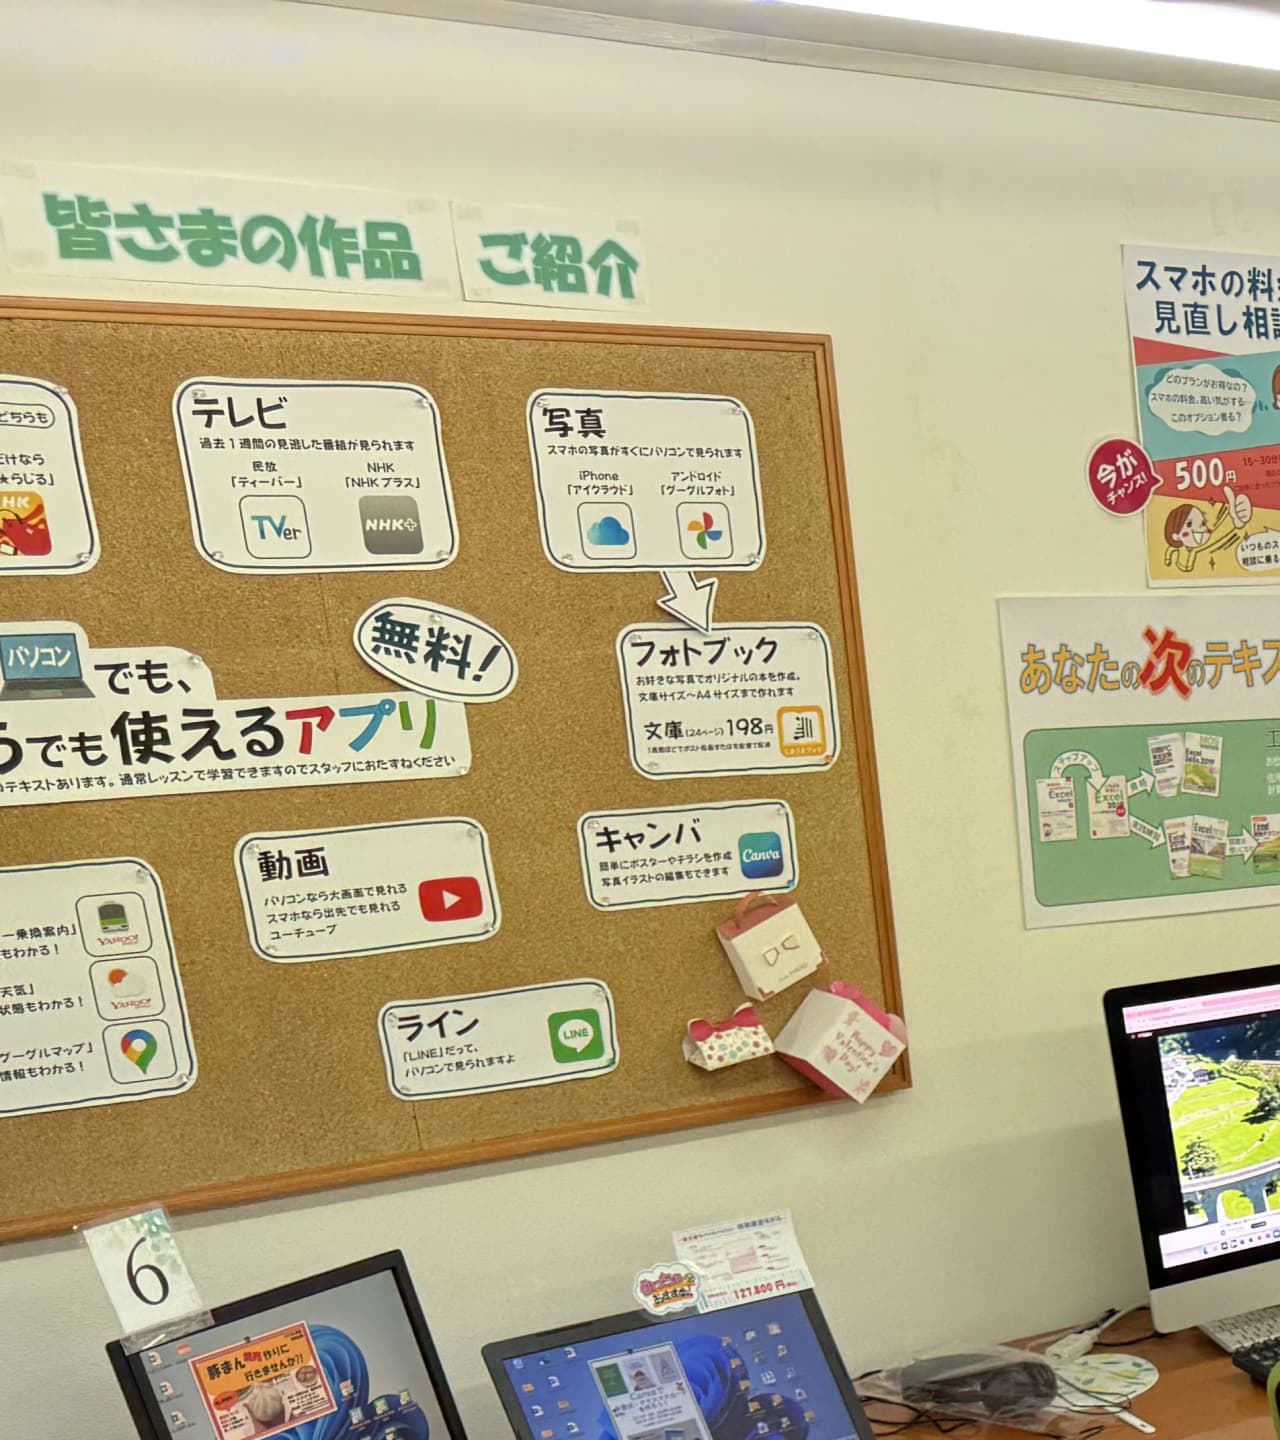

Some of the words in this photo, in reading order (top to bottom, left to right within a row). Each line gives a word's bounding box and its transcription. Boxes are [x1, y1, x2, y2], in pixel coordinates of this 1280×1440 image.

[44, 192, 422, 282] 皆さまの作品
[478, 229, 639, 299] ご紹介
[192, 396, 288, 430] テレビ
[542, 407, 606, 439] 写真
[547, 445, 743, 458] スマホの写真がすぐにパソコンで見られます
[253, 461, 278, 473] 民放
[367, 462, 395, 473] NHK
[579, 470, 619, 482] iPhone
[671, 471, 722, 482] アンドロイド
[1096, 449, 1138, 487] 今が
[1175, 457, 1236, 490] 500円
[251, 515, 302, 541] TVer
[8, 646, 71, 668] パソコン
[630, 636, 778, 667] フォトブック
[94, 660, 191, 694] でも、
[644, 721, 684, 741] 文庫
[726, 718, 774, 736] 198円
[596, 818, 702, 853] キャンバ
[257, 846, 329, 882] 動画
[600, 851, 733, 873] 簡単にポスターやチラシを作成
[742, 849, 781, 863] Canva
[601, 867, 730, 888] 写真イラストの編集もできます
[265, 883, 407, 908] パソコンなら大画面で見れる
[267, 901, 401, 925] スマホなら出先でも見れる
[270, 924, 337, 941] ユーチューブ
[397, 1009, 479, 1042] ライン
[563, 1027, 590, 1041] LINE
[405, 1054, 516, 1078] パソコンで見られますよ
[126, 1236, 170, 1306] 6
[207, 1357, 247, 1382] 豚まん
[263, 1343, 291, 1362] 作りに
